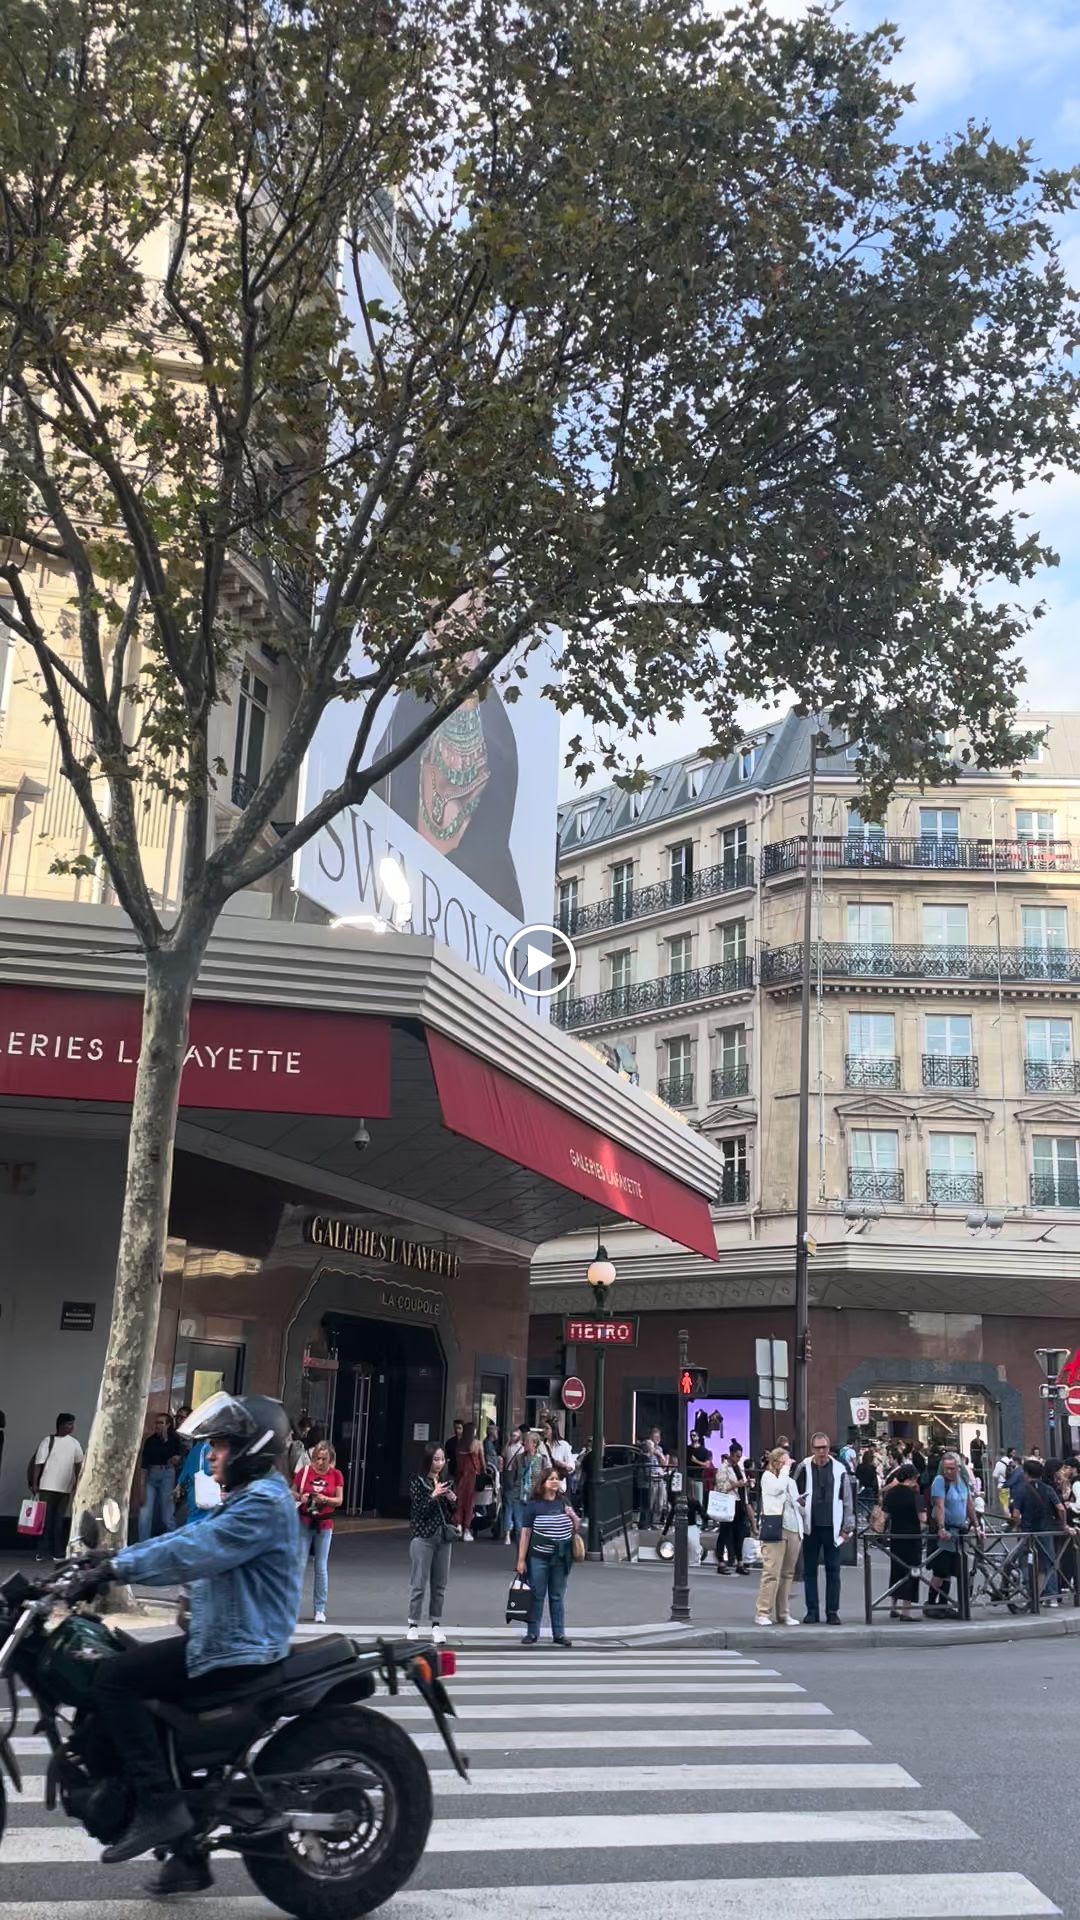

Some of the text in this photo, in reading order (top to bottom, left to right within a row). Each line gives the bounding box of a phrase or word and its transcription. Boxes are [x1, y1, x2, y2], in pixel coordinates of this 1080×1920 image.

[0, 1031, 301, 1074] ERIES LAYETTE
[569, 1148, 643, 1199] GALERIES LAFAYETTE
[312, 1215, 462, 1279] GALERIES LAFAYETTE
[382, 1292, 441, 1316] LA COUPOLE
[570, 1323, 629, 1340] METRO
